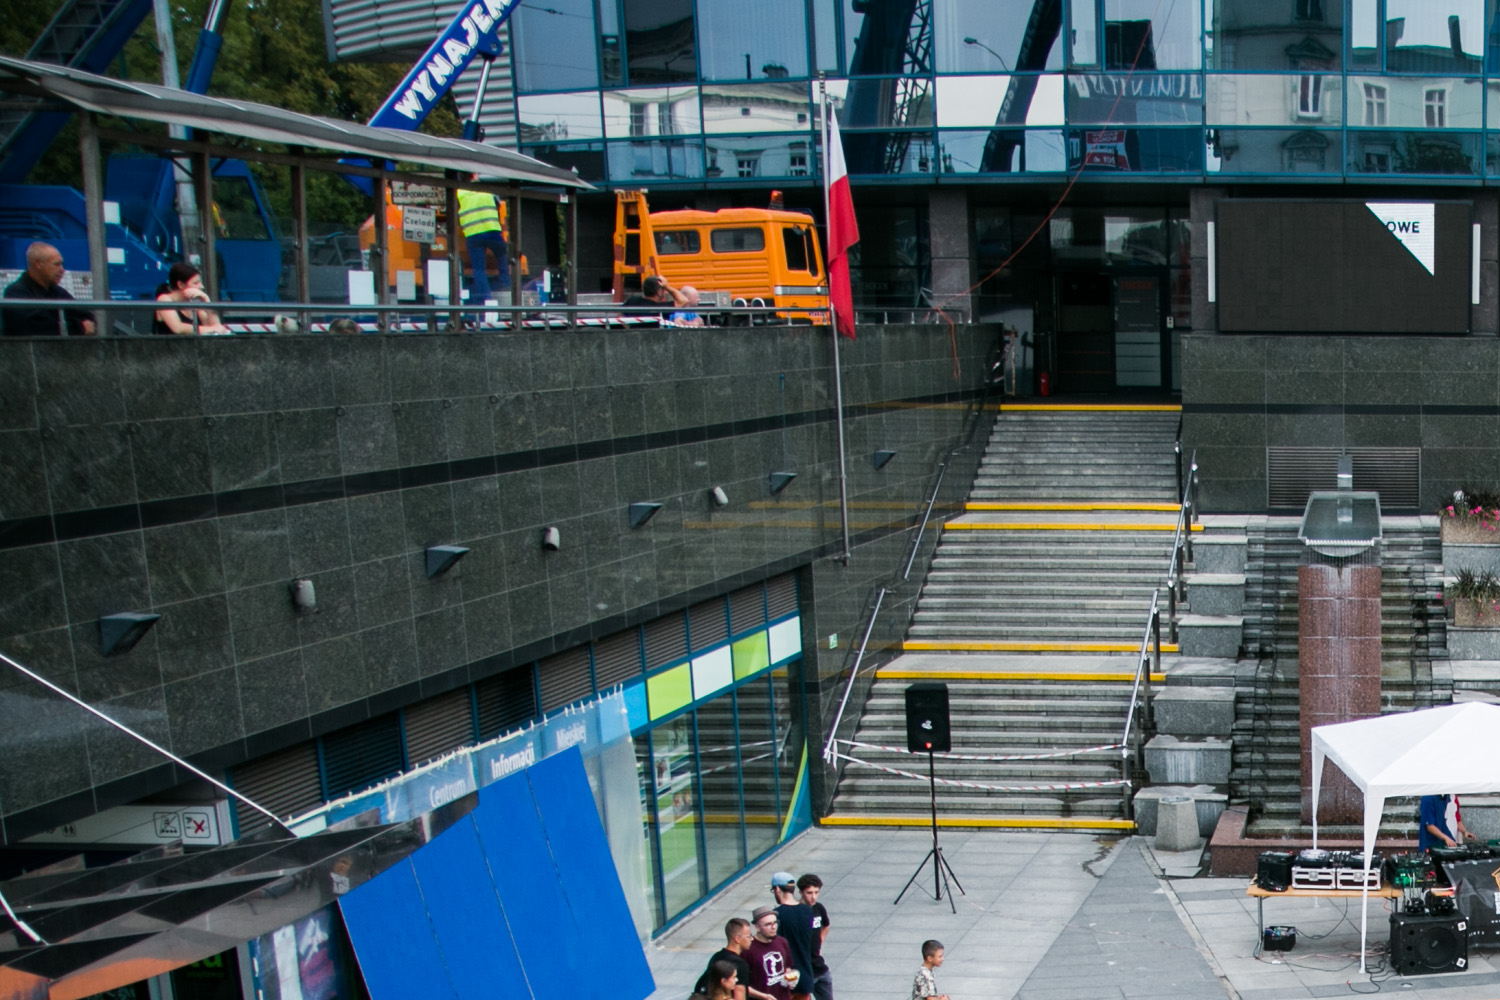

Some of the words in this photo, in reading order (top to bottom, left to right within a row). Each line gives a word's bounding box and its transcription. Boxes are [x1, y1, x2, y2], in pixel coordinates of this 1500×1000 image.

[430, 778, 467, 808] Centrum
[491, 743, 535, 779] Informacji
[556, 720, 587, 750] Miejskiej
